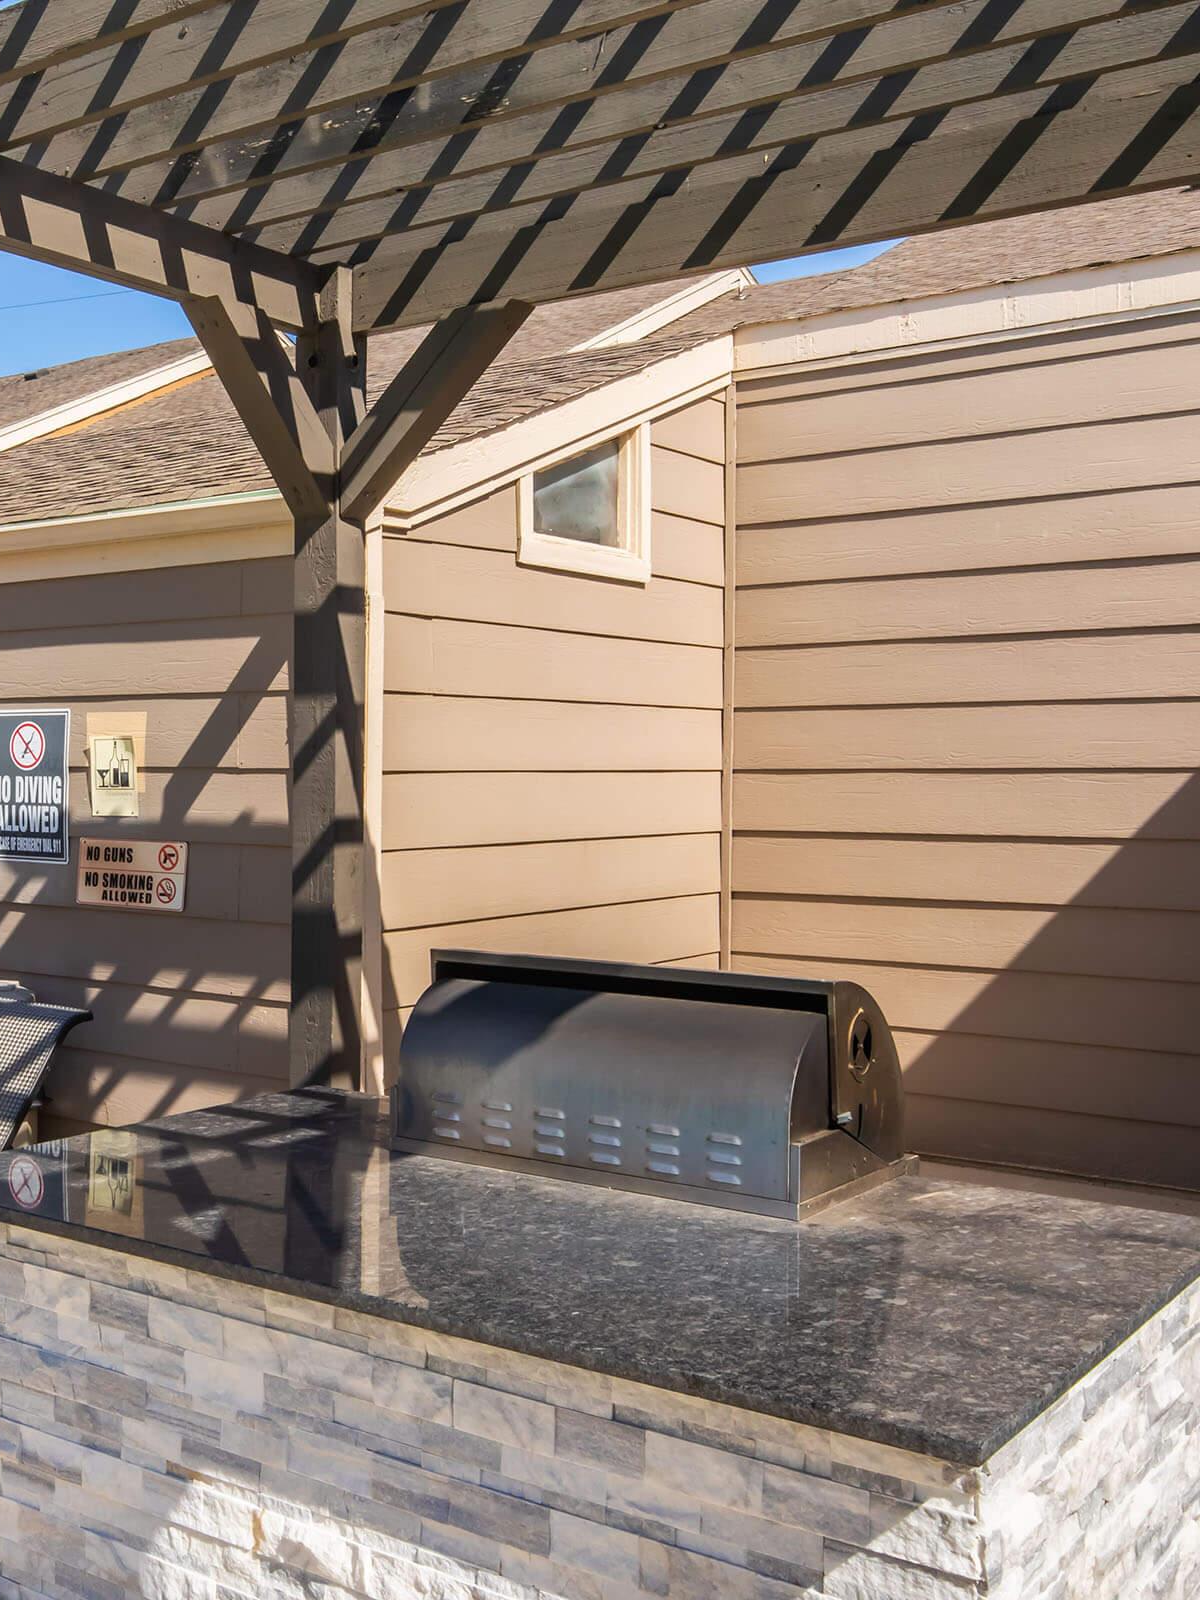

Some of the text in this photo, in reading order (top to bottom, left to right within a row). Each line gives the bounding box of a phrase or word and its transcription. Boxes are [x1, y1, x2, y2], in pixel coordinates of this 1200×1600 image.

[15, 775, 62, 804] DIVING
[0, 836, 10, 850] CASE
[10, 836, 16, 851] OF
[16, 837, 42, 852] EMERGENCY
[42, 838, 53, 853] DIAL
[53, 839, 61, 853] 911
[86, 846, 134, 863] NO GUNS
[84, 871, 154, 891] NO SMOKING
[101, 890, 152, 904] ALLOWED
